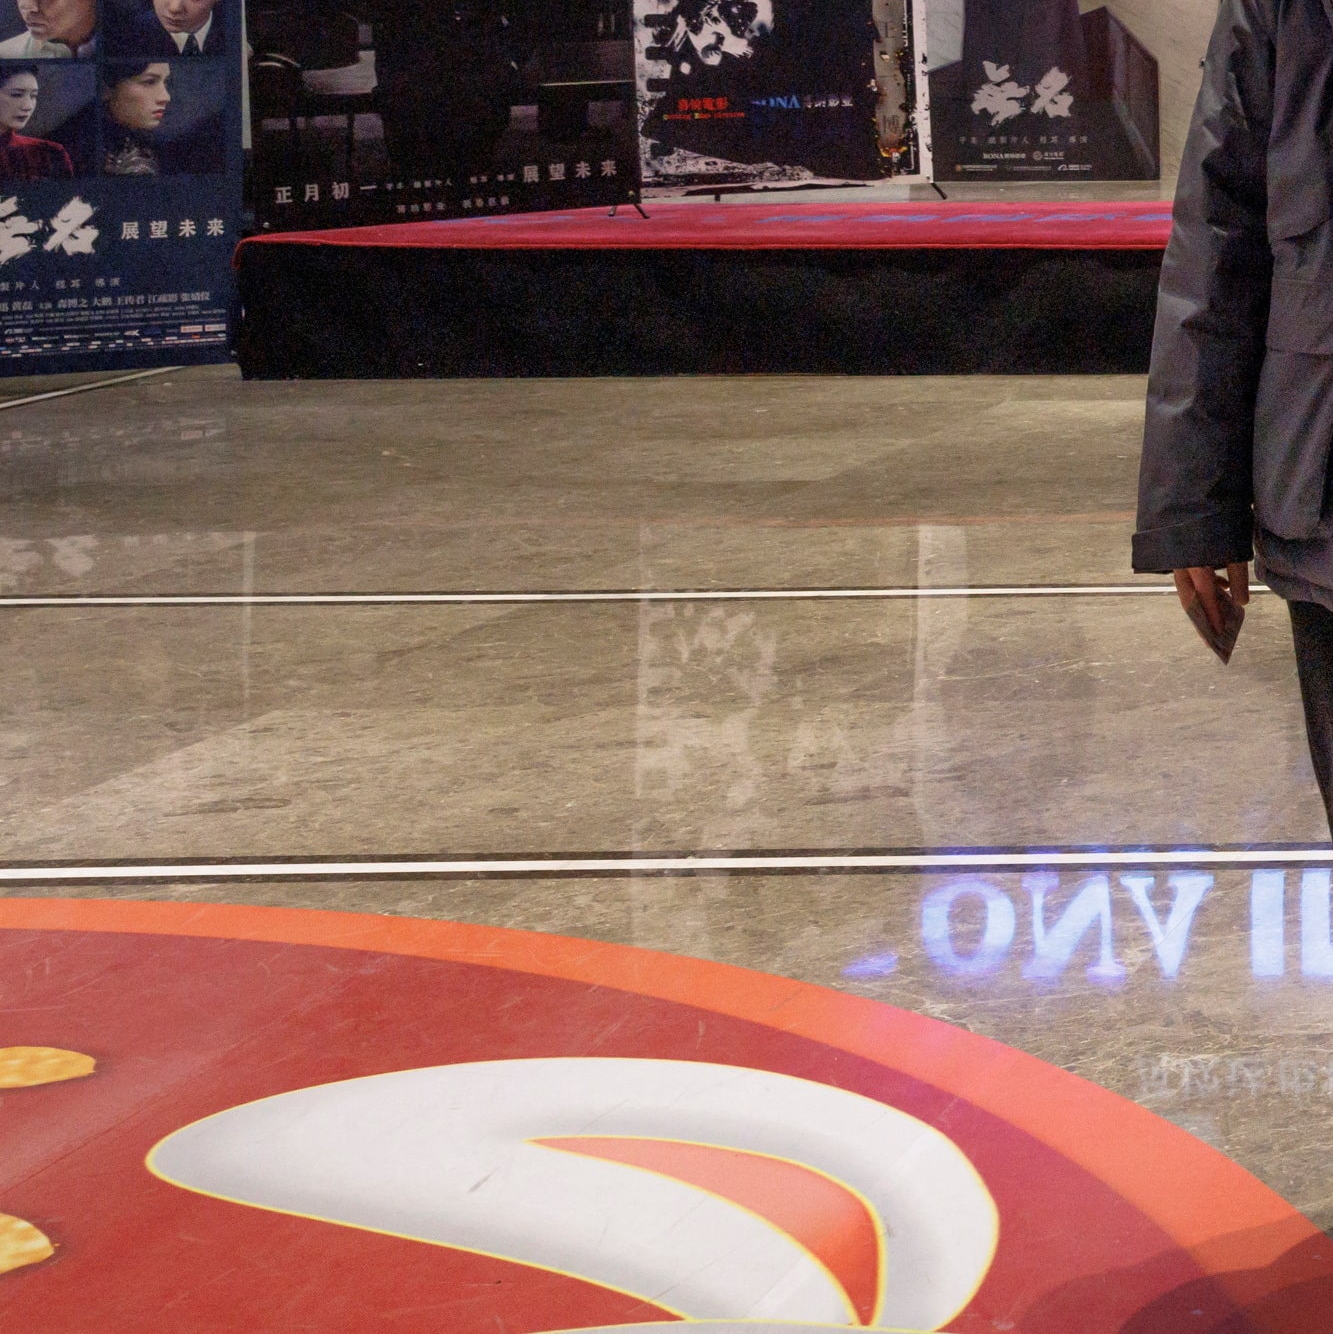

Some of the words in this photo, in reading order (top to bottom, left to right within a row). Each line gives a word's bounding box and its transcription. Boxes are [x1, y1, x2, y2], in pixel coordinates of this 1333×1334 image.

[523, 159, 618, 184] 展望未来
[274, 181, 378, 204] 正月初一
[121, 218, 225, 240] 展望未来
